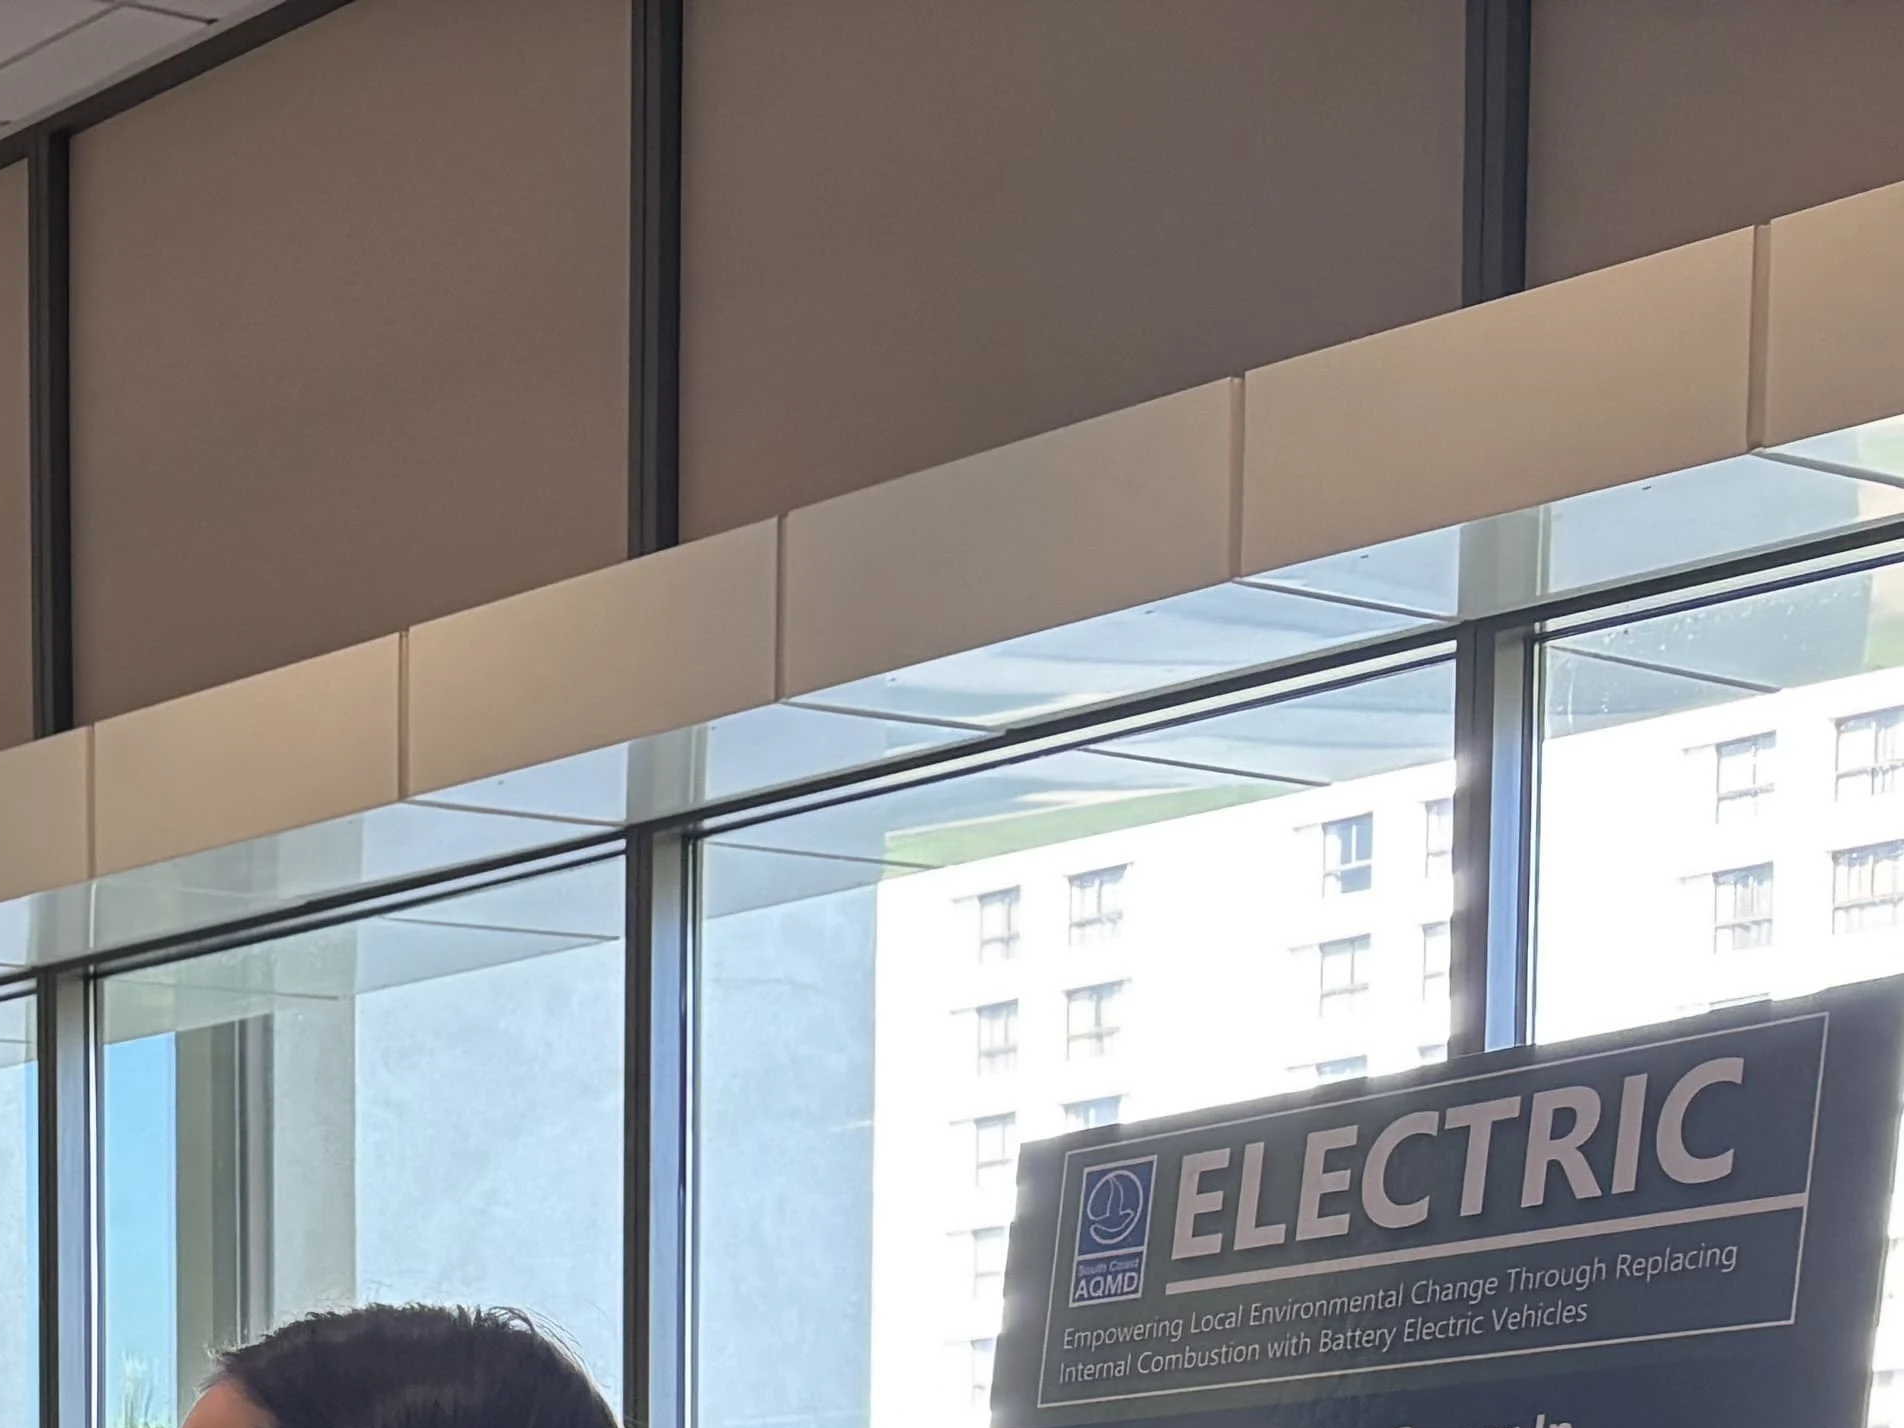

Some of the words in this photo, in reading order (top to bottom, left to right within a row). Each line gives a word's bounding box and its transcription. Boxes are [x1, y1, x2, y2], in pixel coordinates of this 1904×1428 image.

[1172, 1057, 1745, 1260] ELECTRIC
[1064, 1316, 1183, 1352] Empowering
[1192, 1305, 1243, 1333] Local
[1249, 1282, 1403, 1328] Environmental
[1411, 1276, 1498, 1305] Change
[1507, 1258, 1606, 1292] Through
[1616, 1242, 1738, 1283] Replacing
[1074, 1271, 1138, 1300] AQMD
[1060, 1355, 1131, 1384] Internal
[1138, 1339, 1259, 1375] Combustion
[1268, 1330, 1312, 1359] with
[1319, 1324, 1396, 1355] Battery
[1403, 1312, 1484, 1343] Electric
[1492, 1300, 1588, 1332] Vehicles
